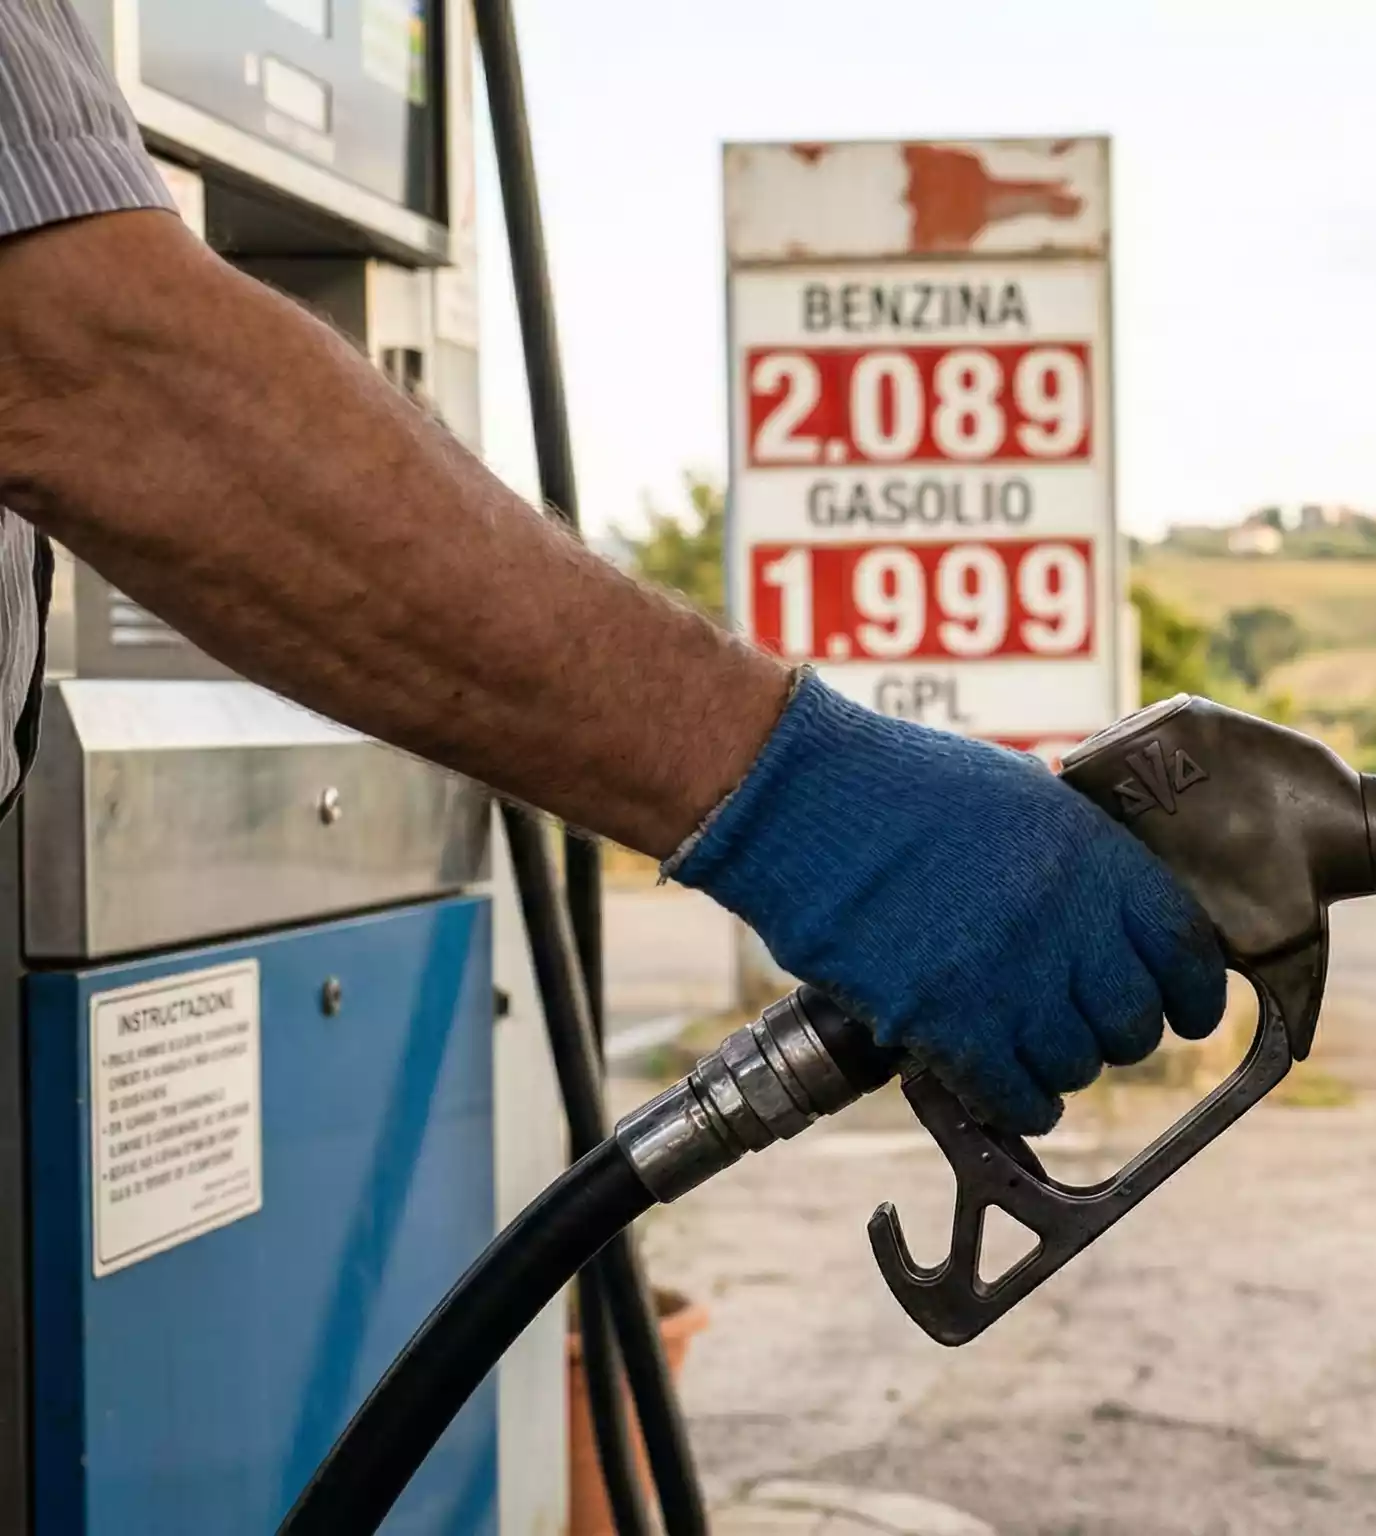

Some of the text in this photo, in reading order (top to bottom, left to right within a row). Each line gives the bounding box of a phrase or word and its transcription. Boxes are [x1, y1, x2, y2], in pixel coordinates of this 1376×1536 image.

[804, 284, 1026, 331] BENZINA
[752, 350, 1085, 462] 2.089
[809, 480, 1032, 526] GASOLIO
[764, 545, 1088, 659] 1.999
[876, 674, 969, 722] GPL
